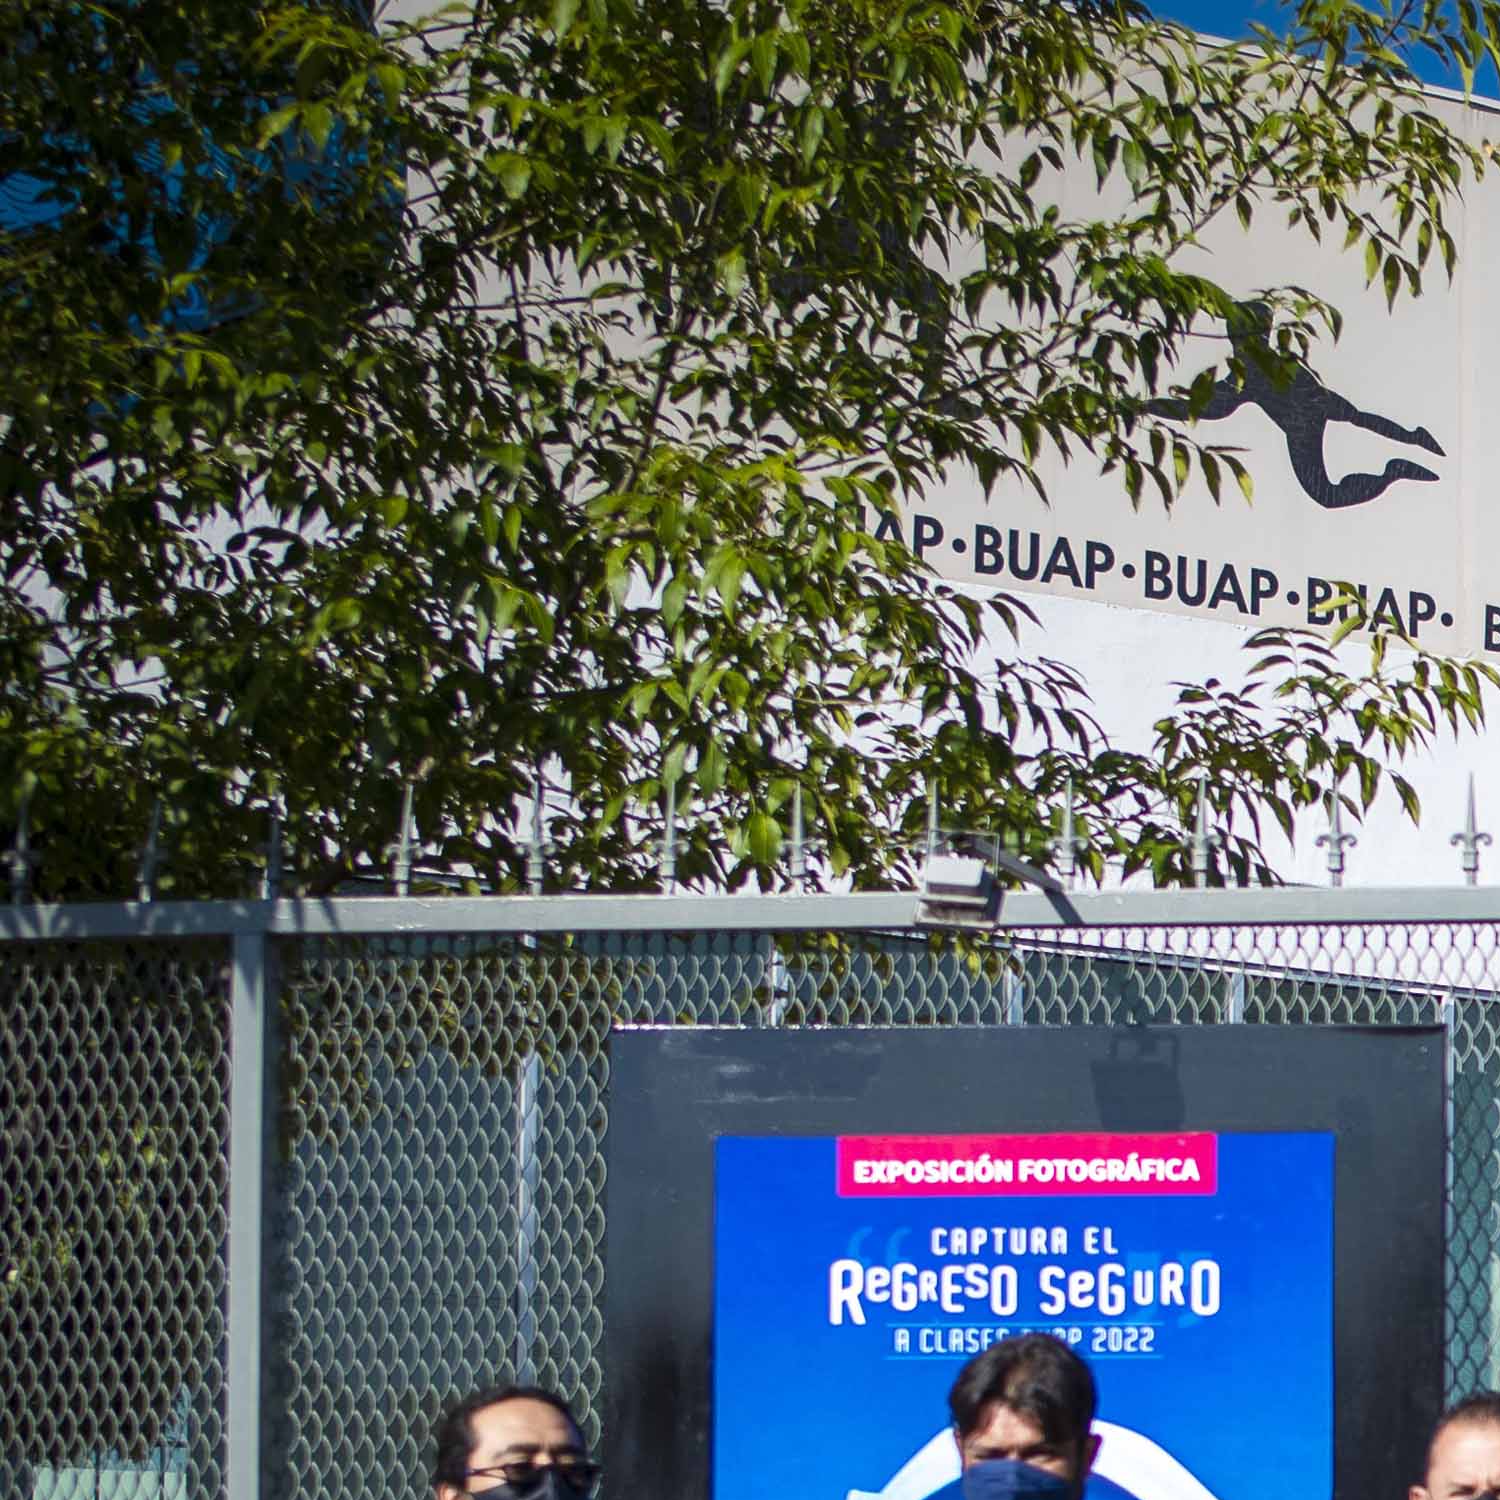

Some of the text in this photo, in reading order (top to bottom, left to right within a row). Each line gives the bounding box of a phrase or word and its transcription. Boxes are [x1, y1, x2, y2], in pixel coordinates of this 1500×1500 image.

[974, 523, 1114, 590] BUAP
[1144, 550, 1279, 617] BUAP
[853, 1152, 1200, 1184] EXPOSICIÓN FOTOGRÁFICA
[930, 1226, 1119, 1256] CAPTURA EL
[894, 1328, 910, 1353] A
[1091, 1327, 1154, 1353] 2022
